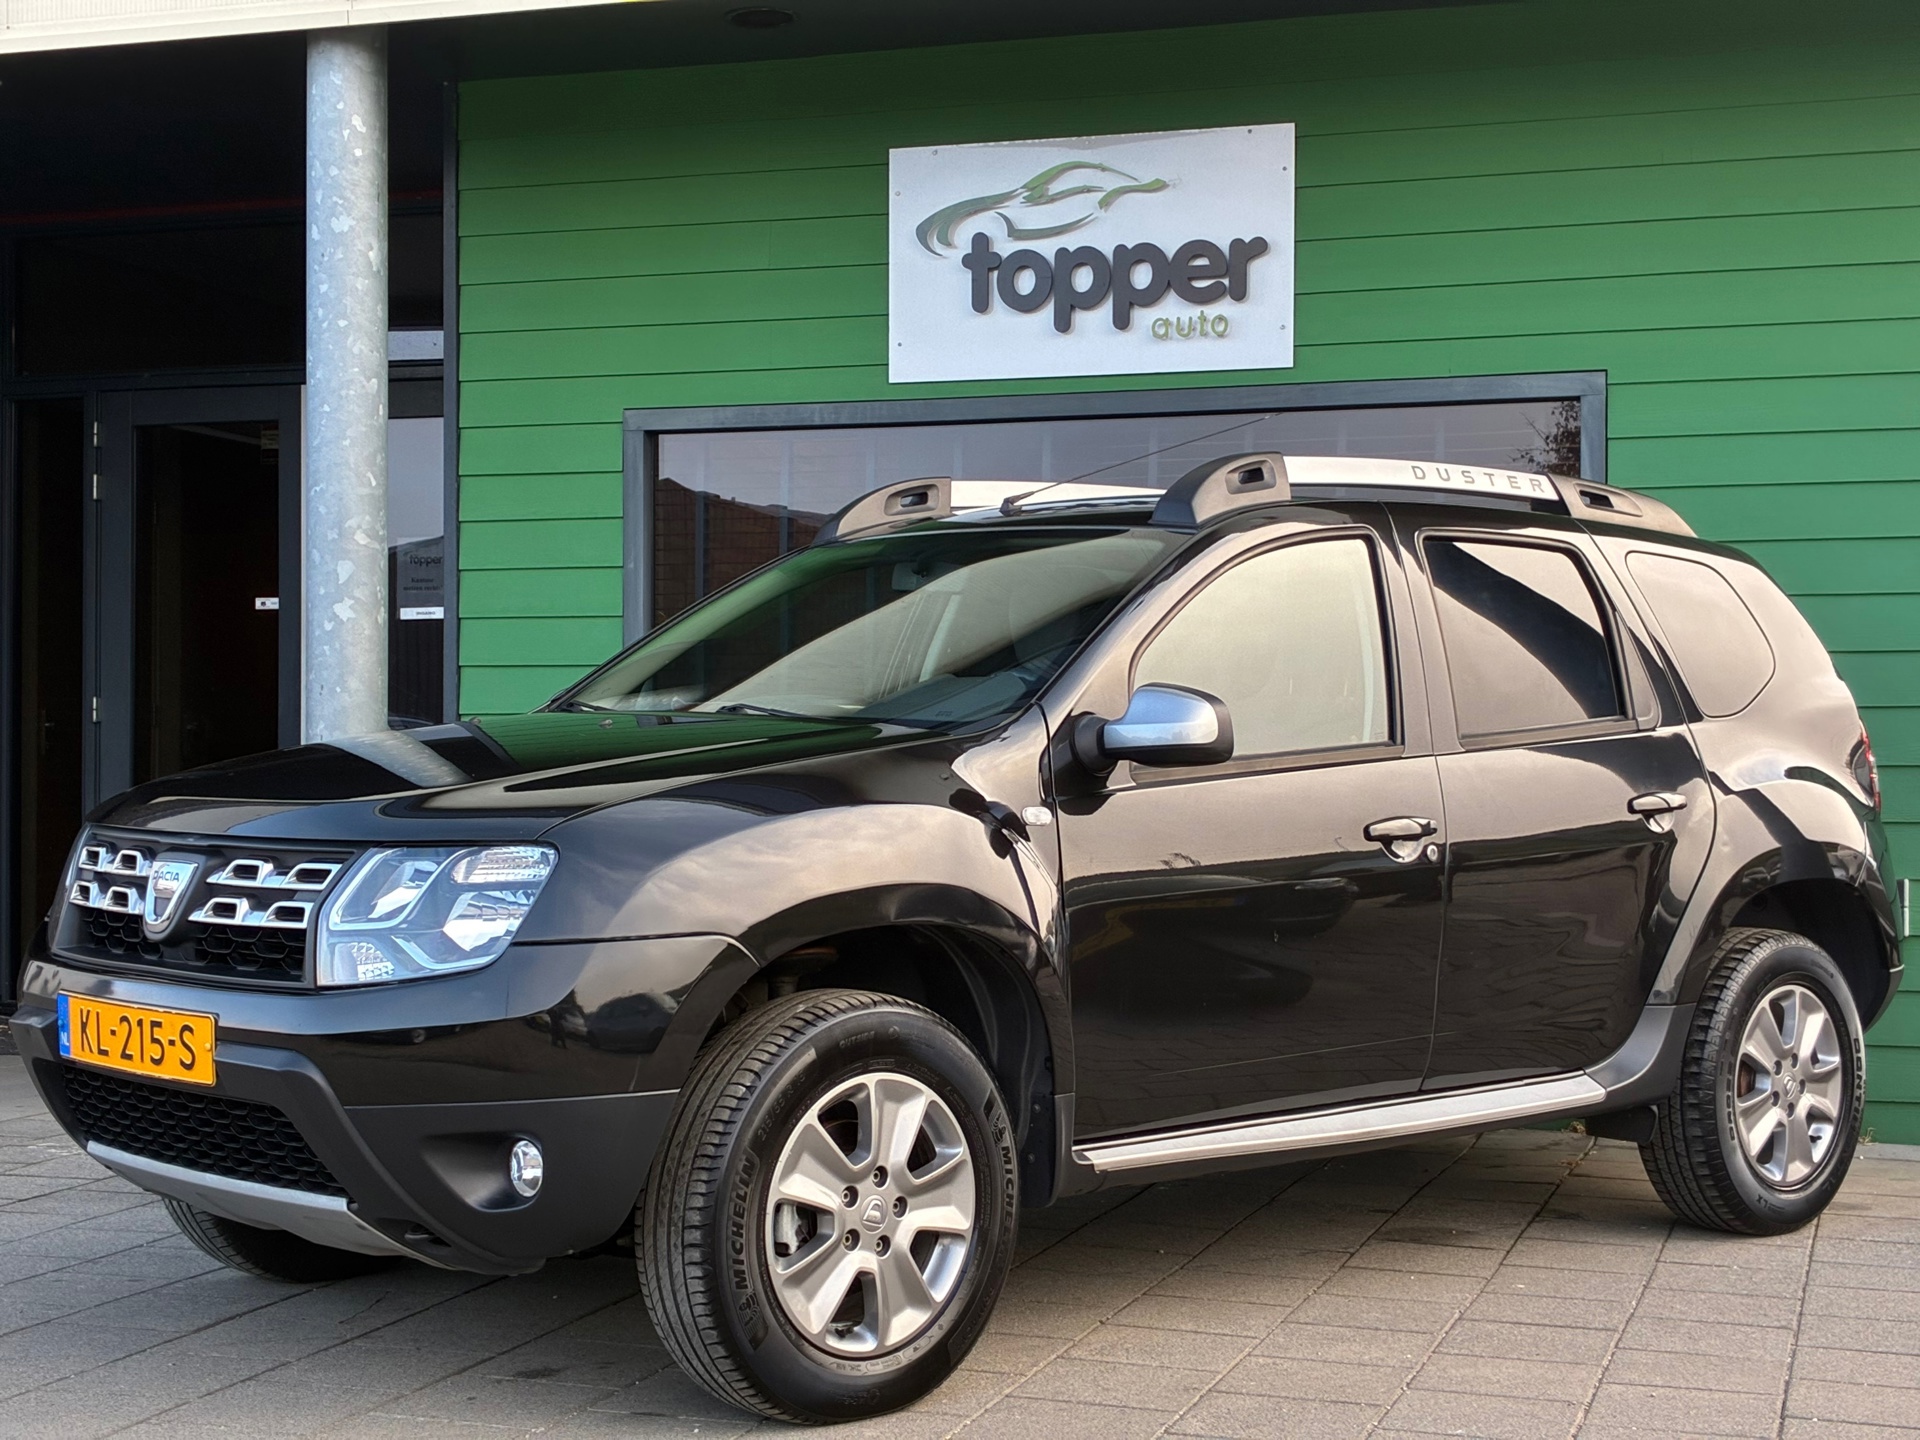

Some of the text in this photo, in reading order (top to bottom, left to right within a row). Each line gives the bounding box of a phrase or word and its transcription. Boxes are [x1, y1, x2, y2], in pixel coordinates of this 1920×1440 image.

[961, 231, 1268, 333] topper
[1151, 310, 1229, 340] auto
[1410, 465, 1545, 493] DUSTER
[409, 554, 443, 567] topper
[152, 870, 180, 882] DACIA
[60, 1031, 70, 1047] NL
[78, 1006, 196, 1071] KL-215-S
[730, 1155, 757, 1290] MICHELIN
